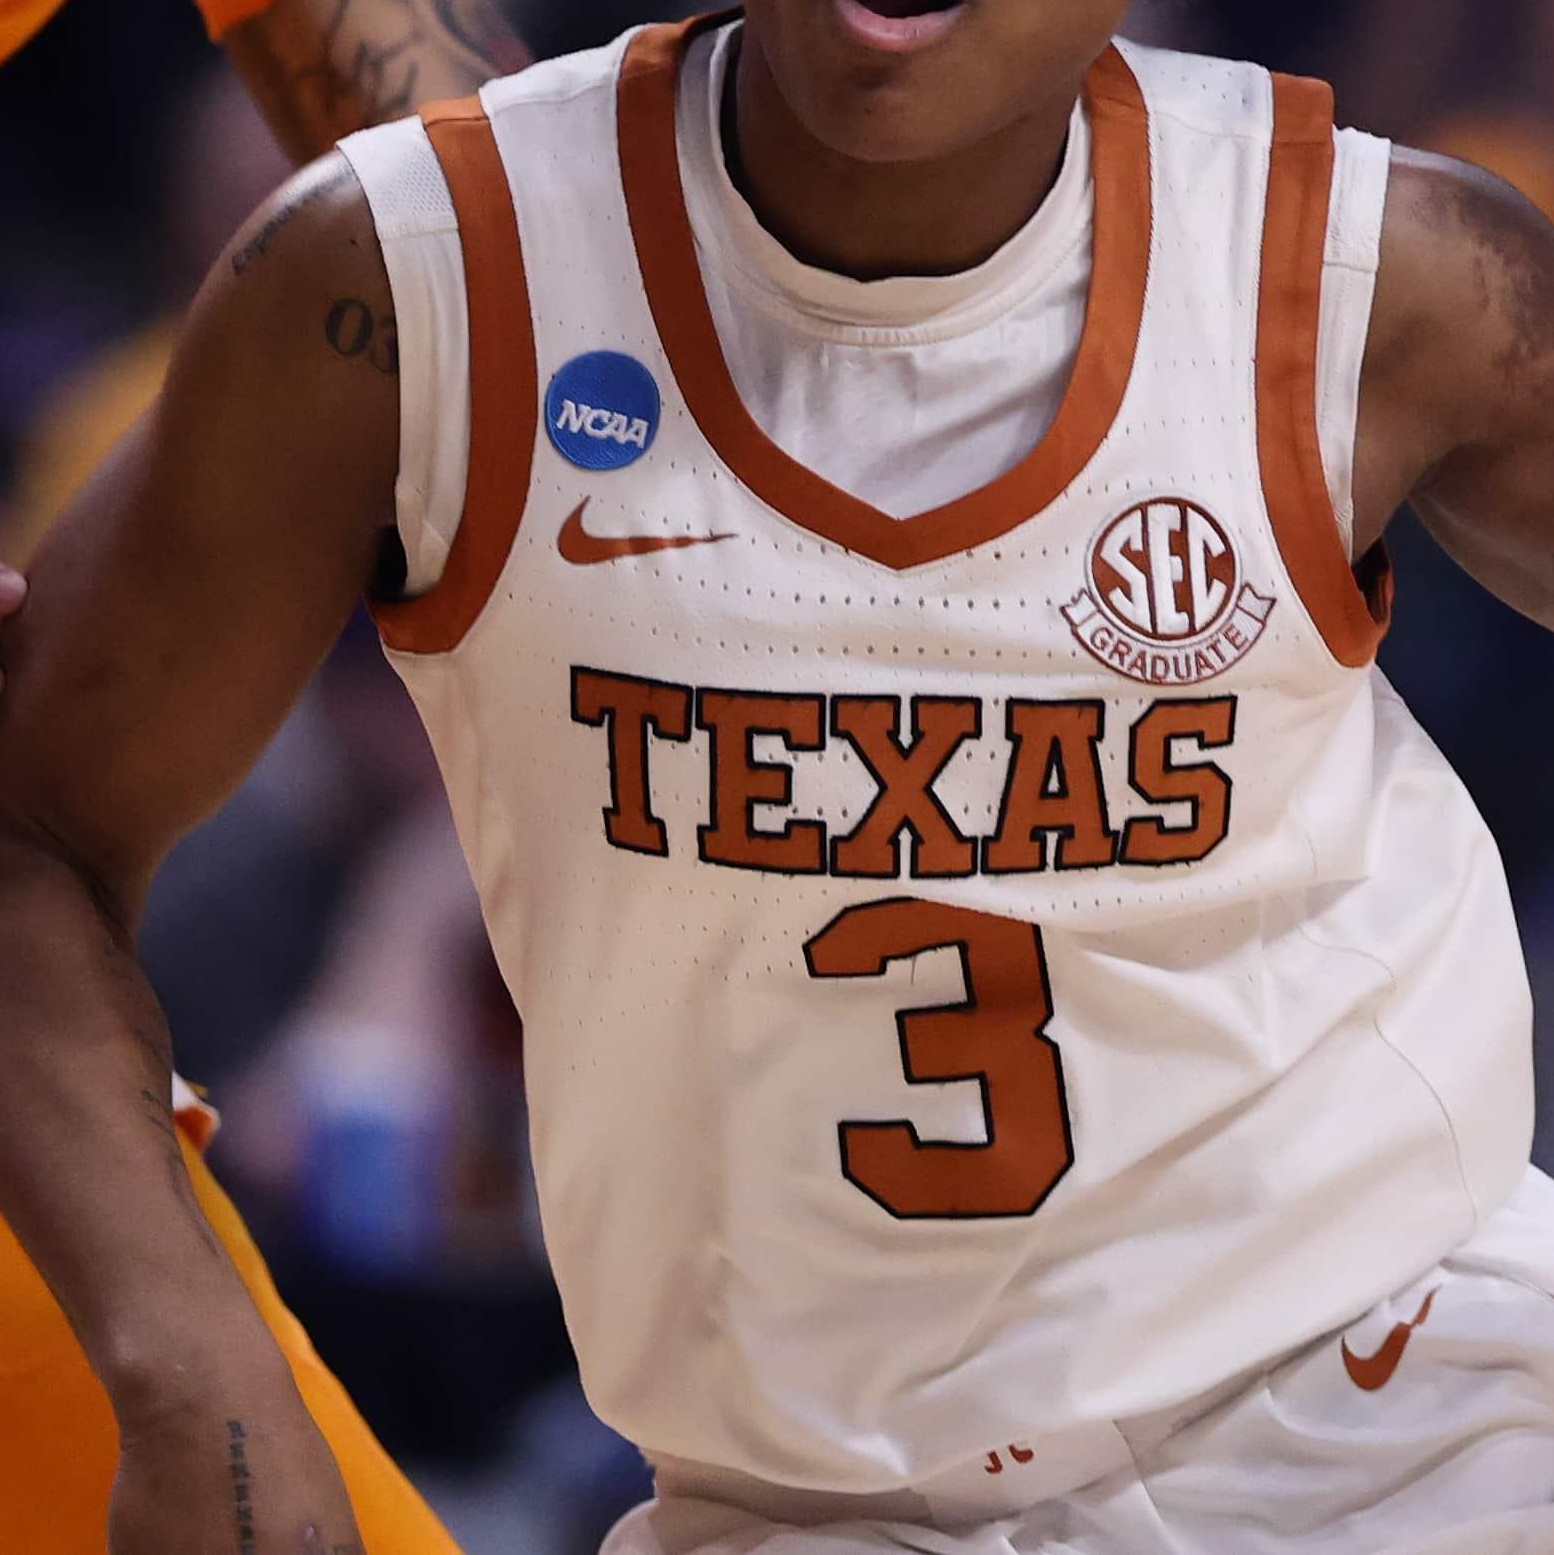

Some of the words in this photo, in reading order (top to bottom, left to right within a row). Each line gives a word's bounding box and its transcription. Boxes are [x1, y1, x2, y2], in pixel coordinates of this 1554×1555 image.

[556, 397, 649, 450] NCAA
[1099, 502, 1228, 636] SEC
[1090, 622, 1250, 686] GRADUATE
[570, 665, 1237, 879] TEXAS
[802, 896, 1075, 1221] 3
